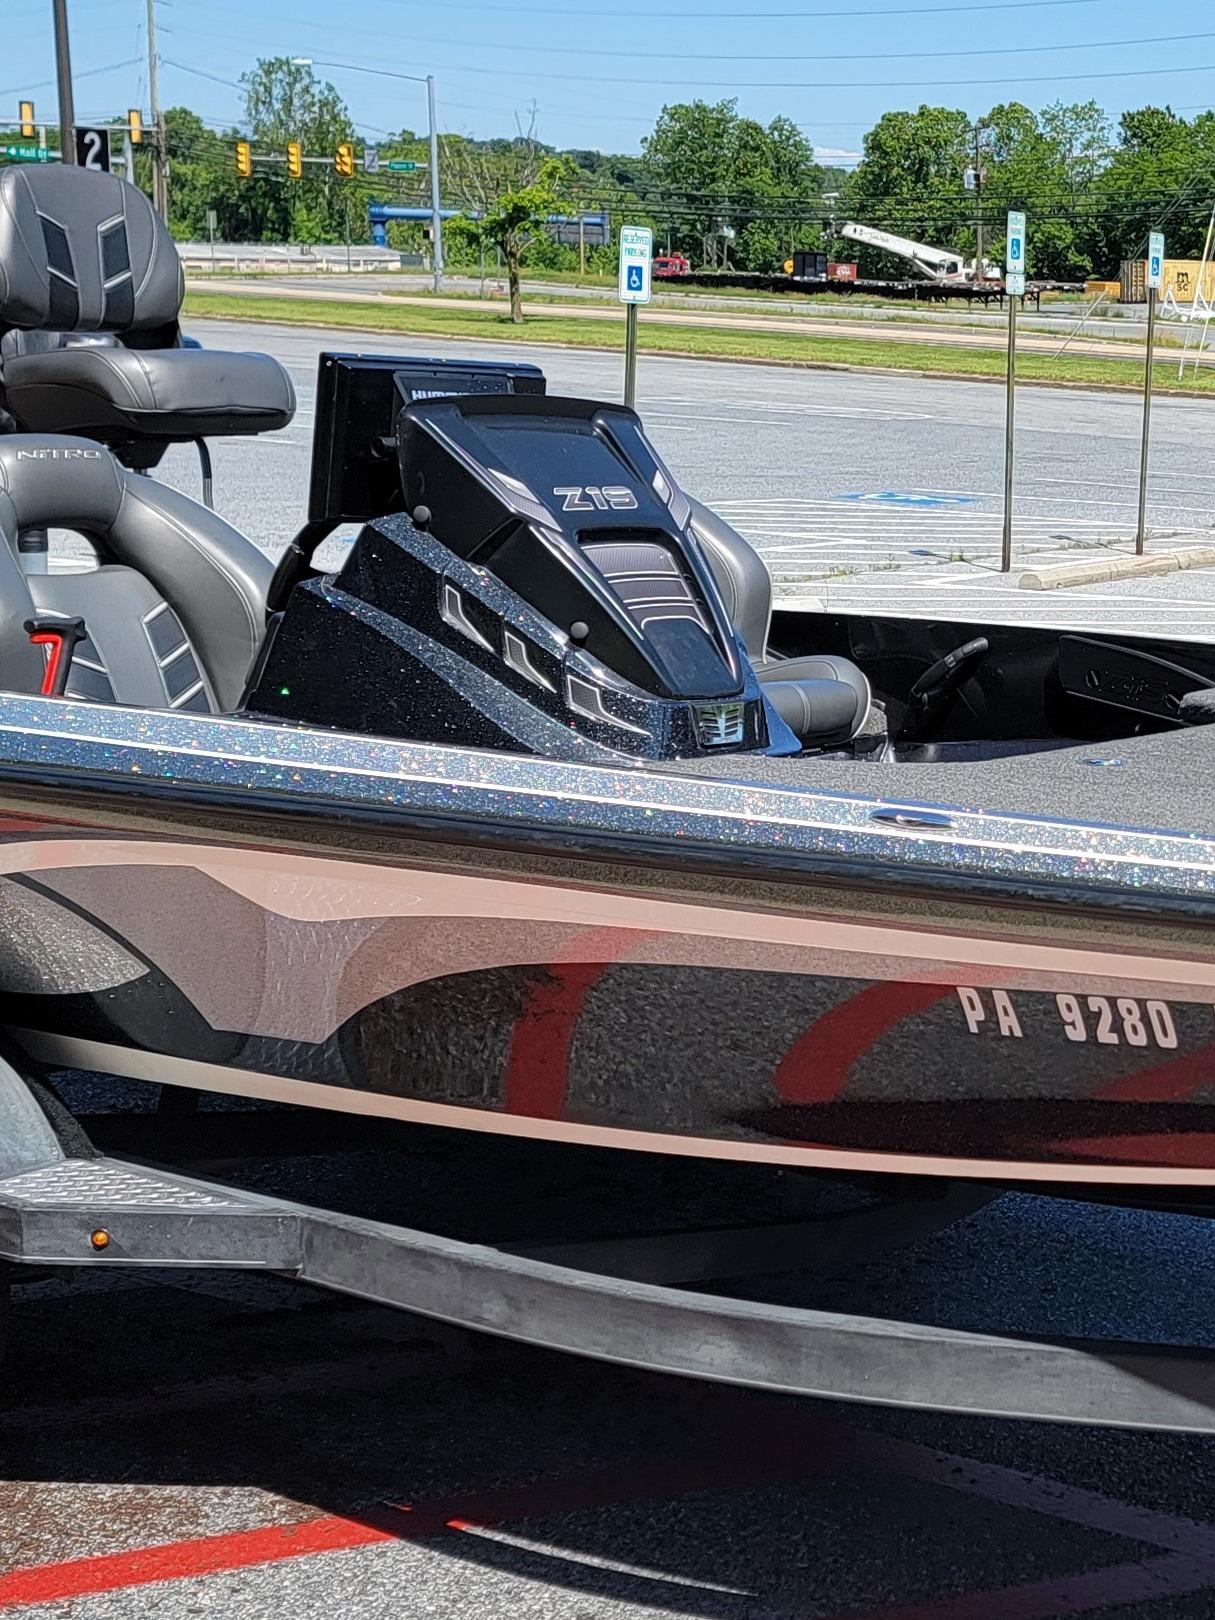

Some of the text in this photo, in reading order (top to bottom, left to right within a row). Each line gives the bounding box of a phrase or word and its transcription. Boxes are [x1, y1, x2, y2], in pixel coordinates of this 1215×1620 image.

[84, 131, 102, 171] 2
[17, 448, 101, 461] NITRO
[553, 486, 639, 511] Z19
[956, 986, 1024, 1038] PA
[1055, 993, 1178, 1049] 9280
